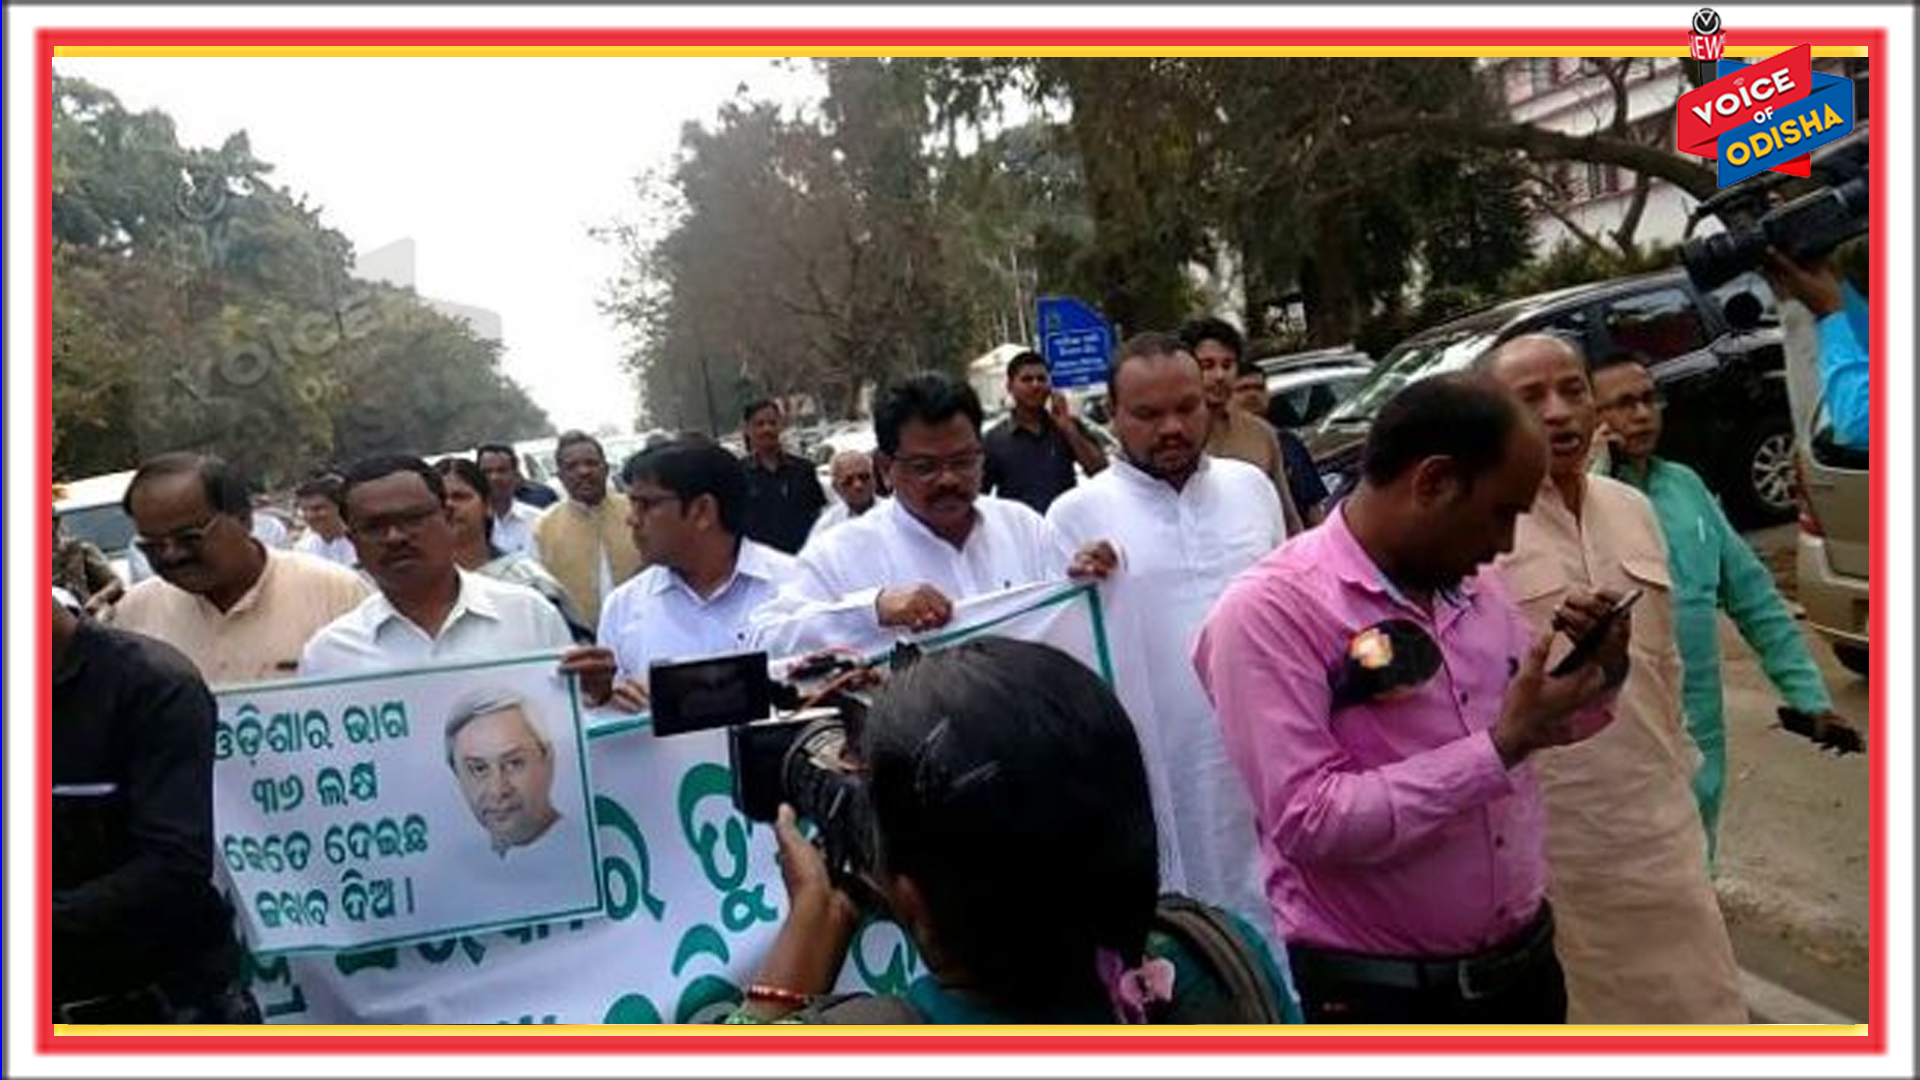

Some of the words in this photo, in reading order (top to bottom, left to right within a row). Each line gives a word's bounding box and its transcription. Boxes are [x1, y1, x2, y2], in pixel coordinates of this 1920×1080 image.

[214, 703, 333, 765] ଓଡ଼ିଶାର
[343, 701, 409, 744] ଭାଗ
[252, 774, 304, 814] ୩୬
[317, 761, 378, 807] ଲକ୍ଷ
